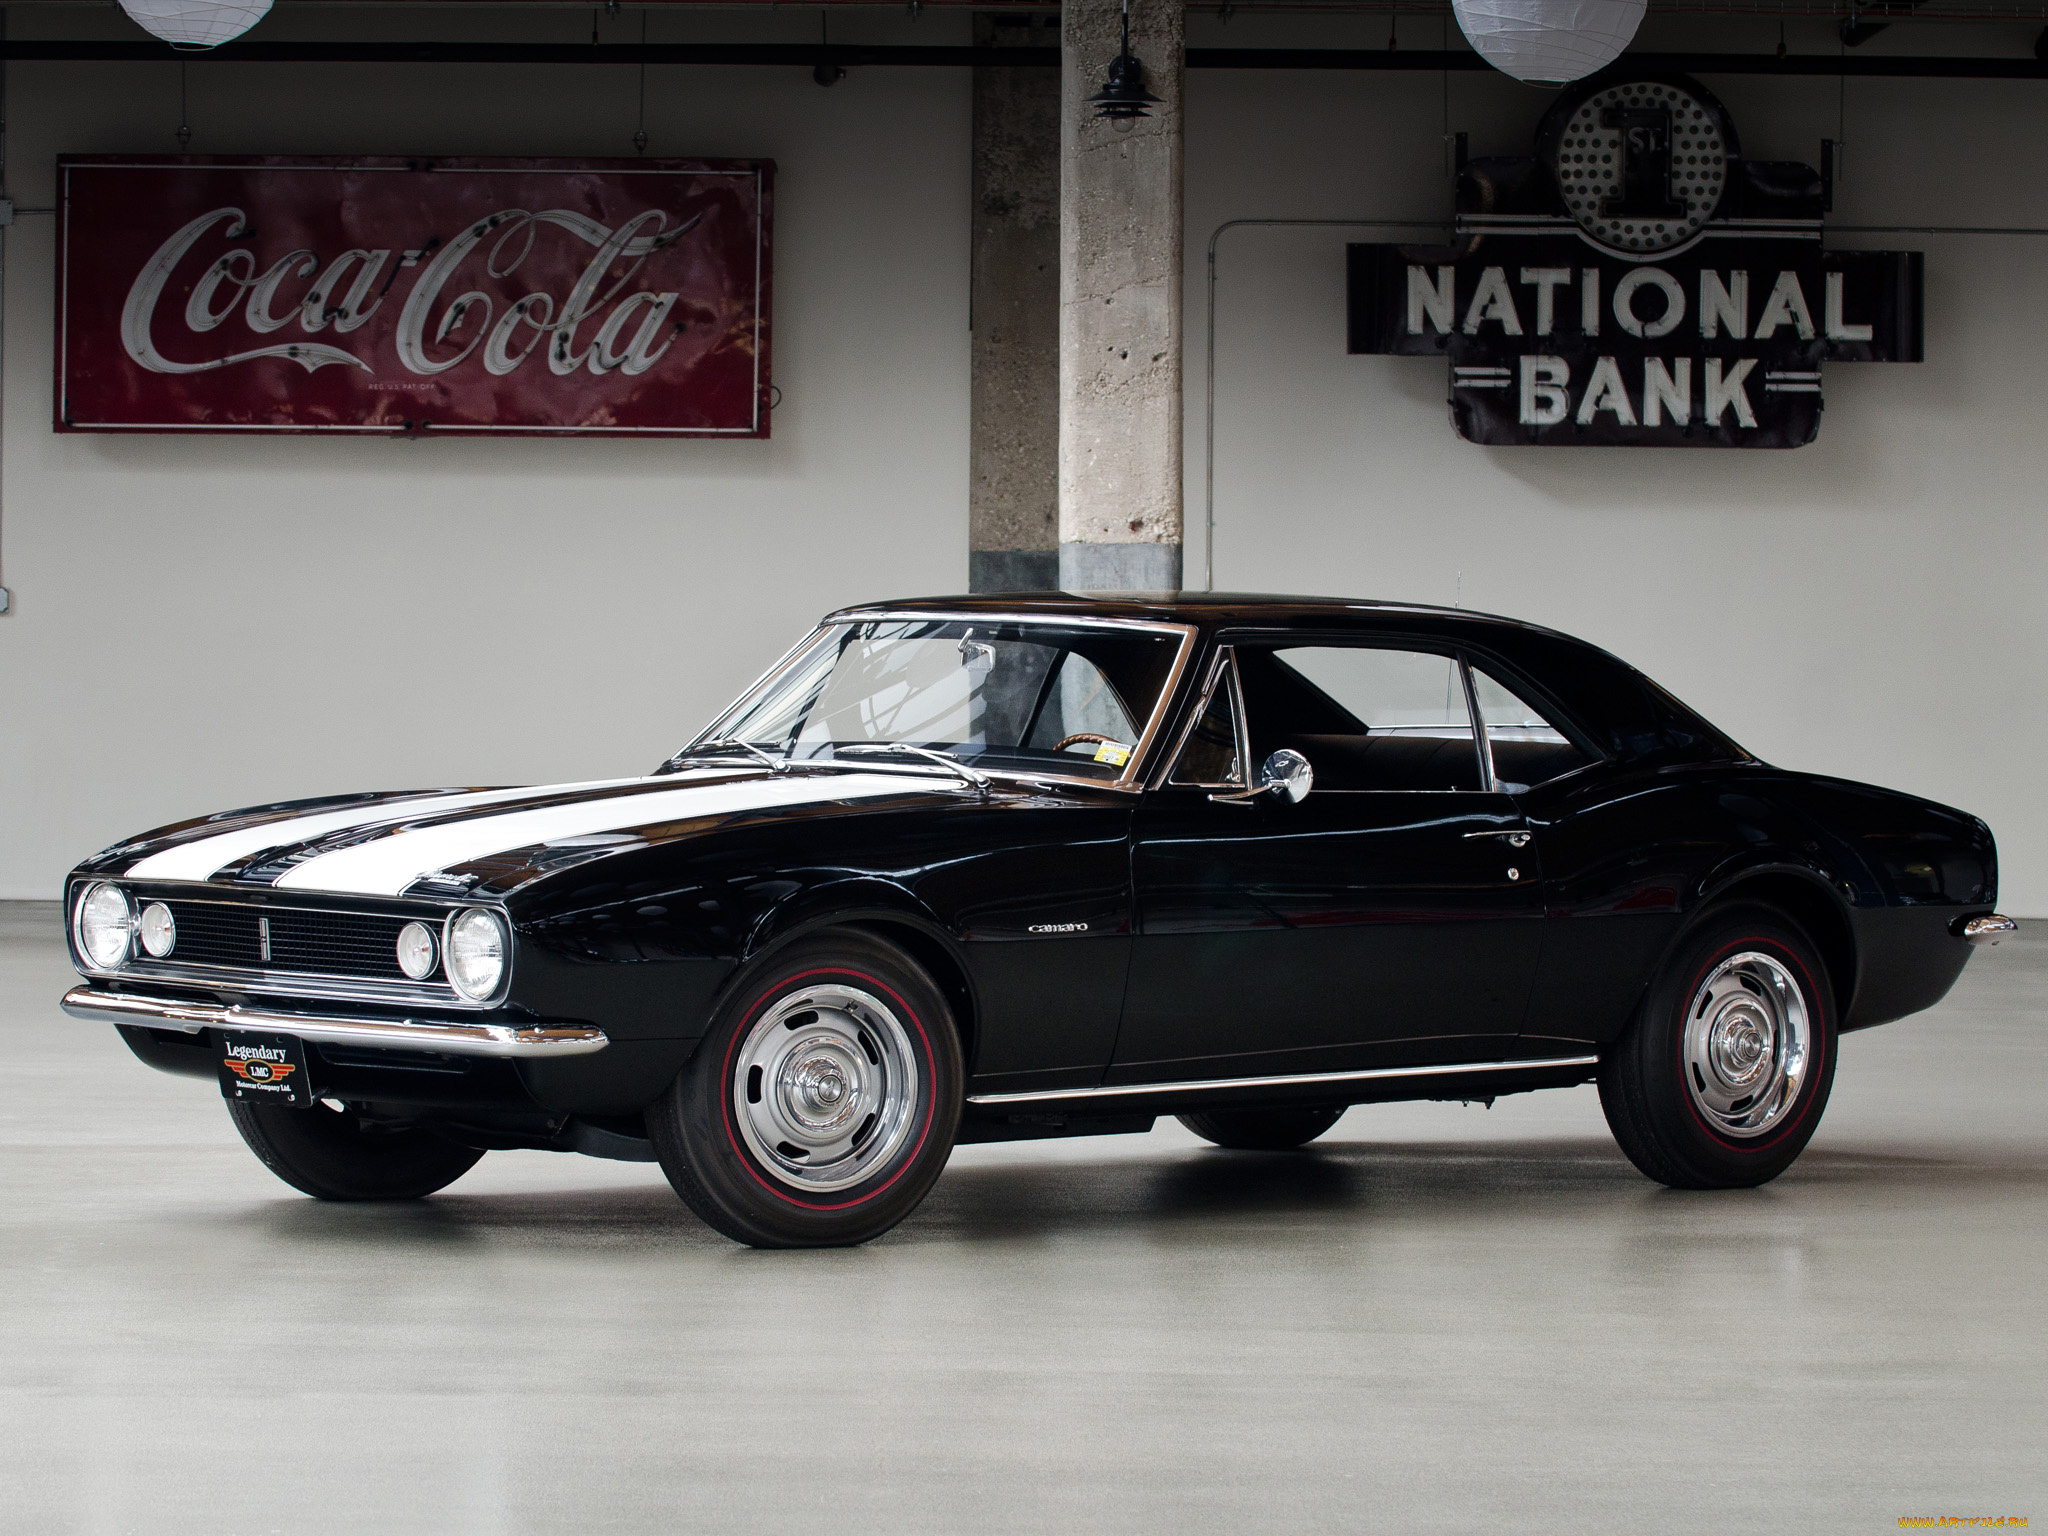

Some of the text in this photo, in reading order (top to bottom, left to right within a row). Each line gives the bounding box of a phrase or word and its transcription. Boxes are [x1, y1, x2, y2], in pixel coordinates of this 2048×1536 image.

[1406, 266, 1873, 341] NATIONAL
[1519, 355, 1758, 428] BANK
[225, 1041, 286, 1063] Legendary
[250, 1066, 269, 1077] LMC
[256, 1082, 280, 1092] Company
